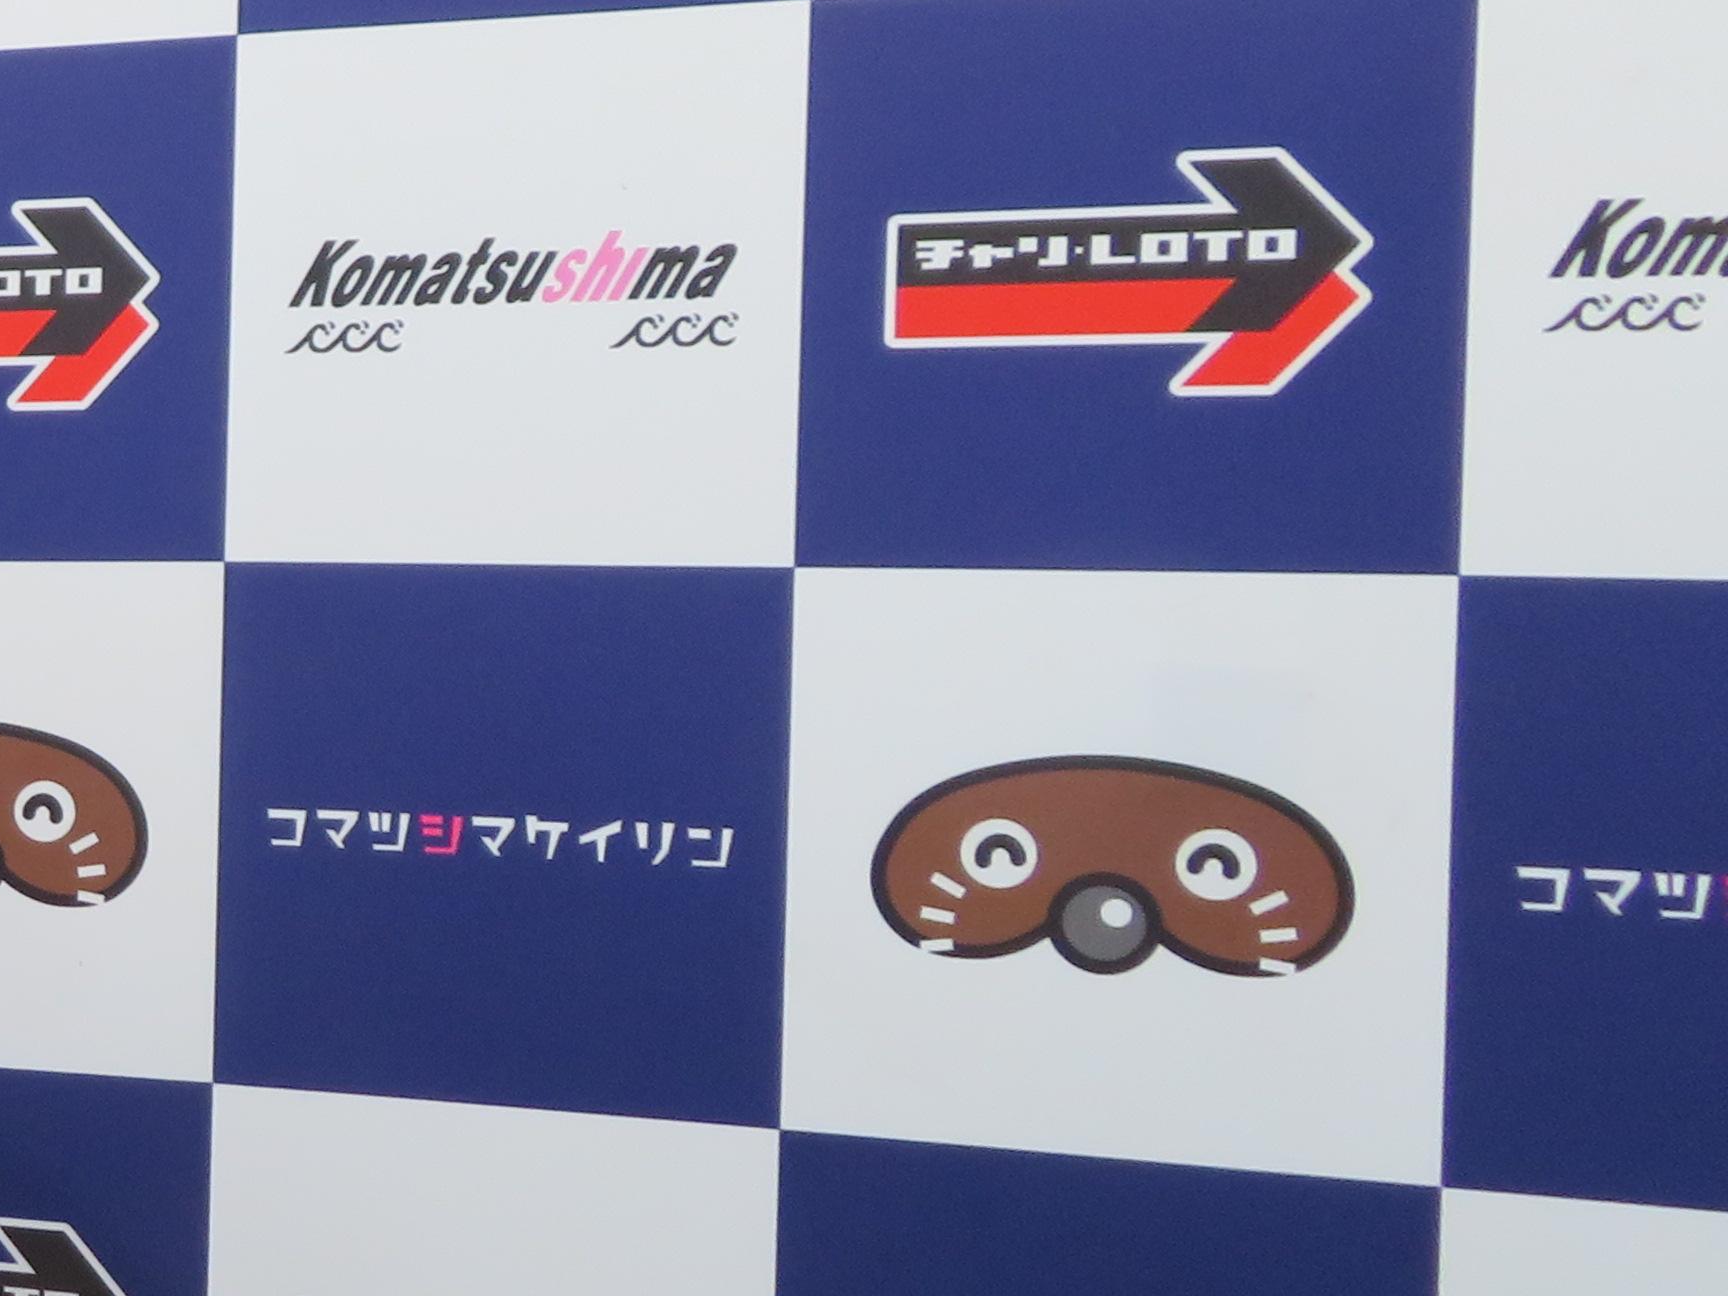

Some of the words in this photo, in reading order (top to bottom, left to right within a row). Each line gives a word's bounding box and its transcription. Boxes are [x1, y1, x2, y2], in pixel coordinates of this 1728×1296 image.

[288, 230, 738, 308] Komatsushima
[1548, 198, 1728, 279] Kom
[267, 808, 734, 868] コマツシマケイリン
[1516, 866, 1728, 920] コマツ
